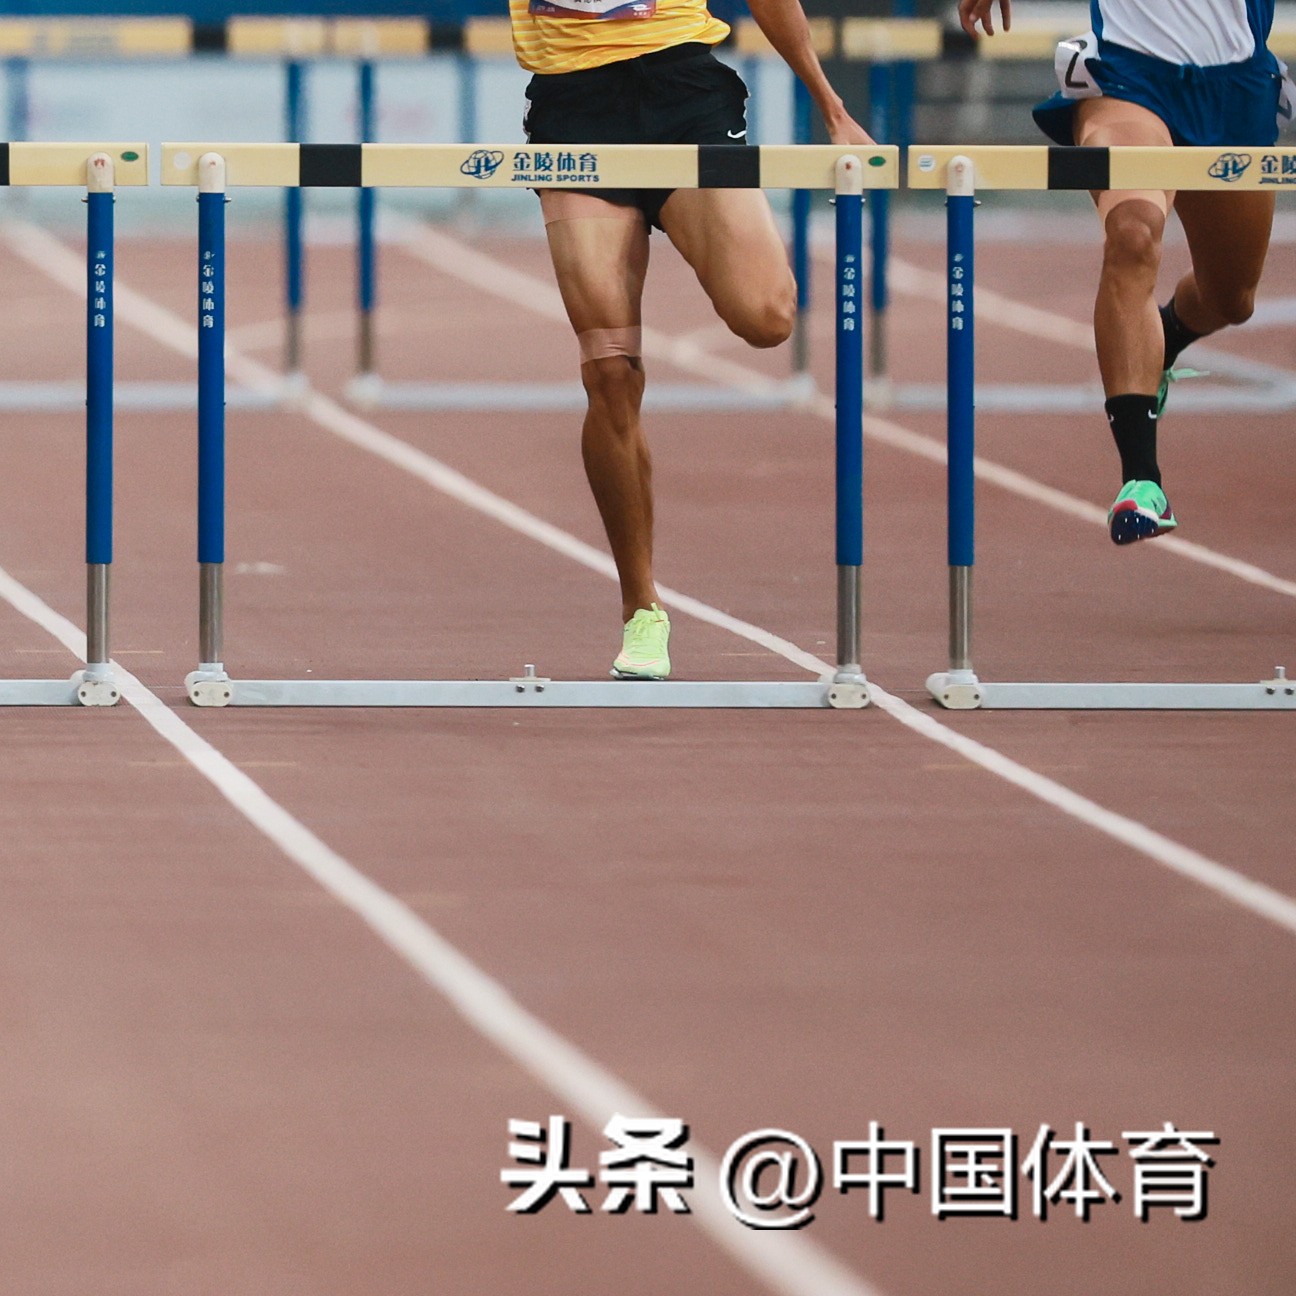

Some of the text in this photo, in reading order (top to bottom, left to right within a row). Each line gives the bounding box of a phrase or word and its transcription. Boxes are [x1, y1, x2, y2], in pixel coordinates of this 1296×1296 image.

[511, 174, 599, 182] JINLING SPORTS
[513, 152, 598, 172] 金陵体育
[94, 263, 106, 328] 金陵体育
[202, 264, 214, 329] 金陵体育
[842, 267, 855, 331] 金陵体育
[951, 266, 964, 331] 金陵体育
